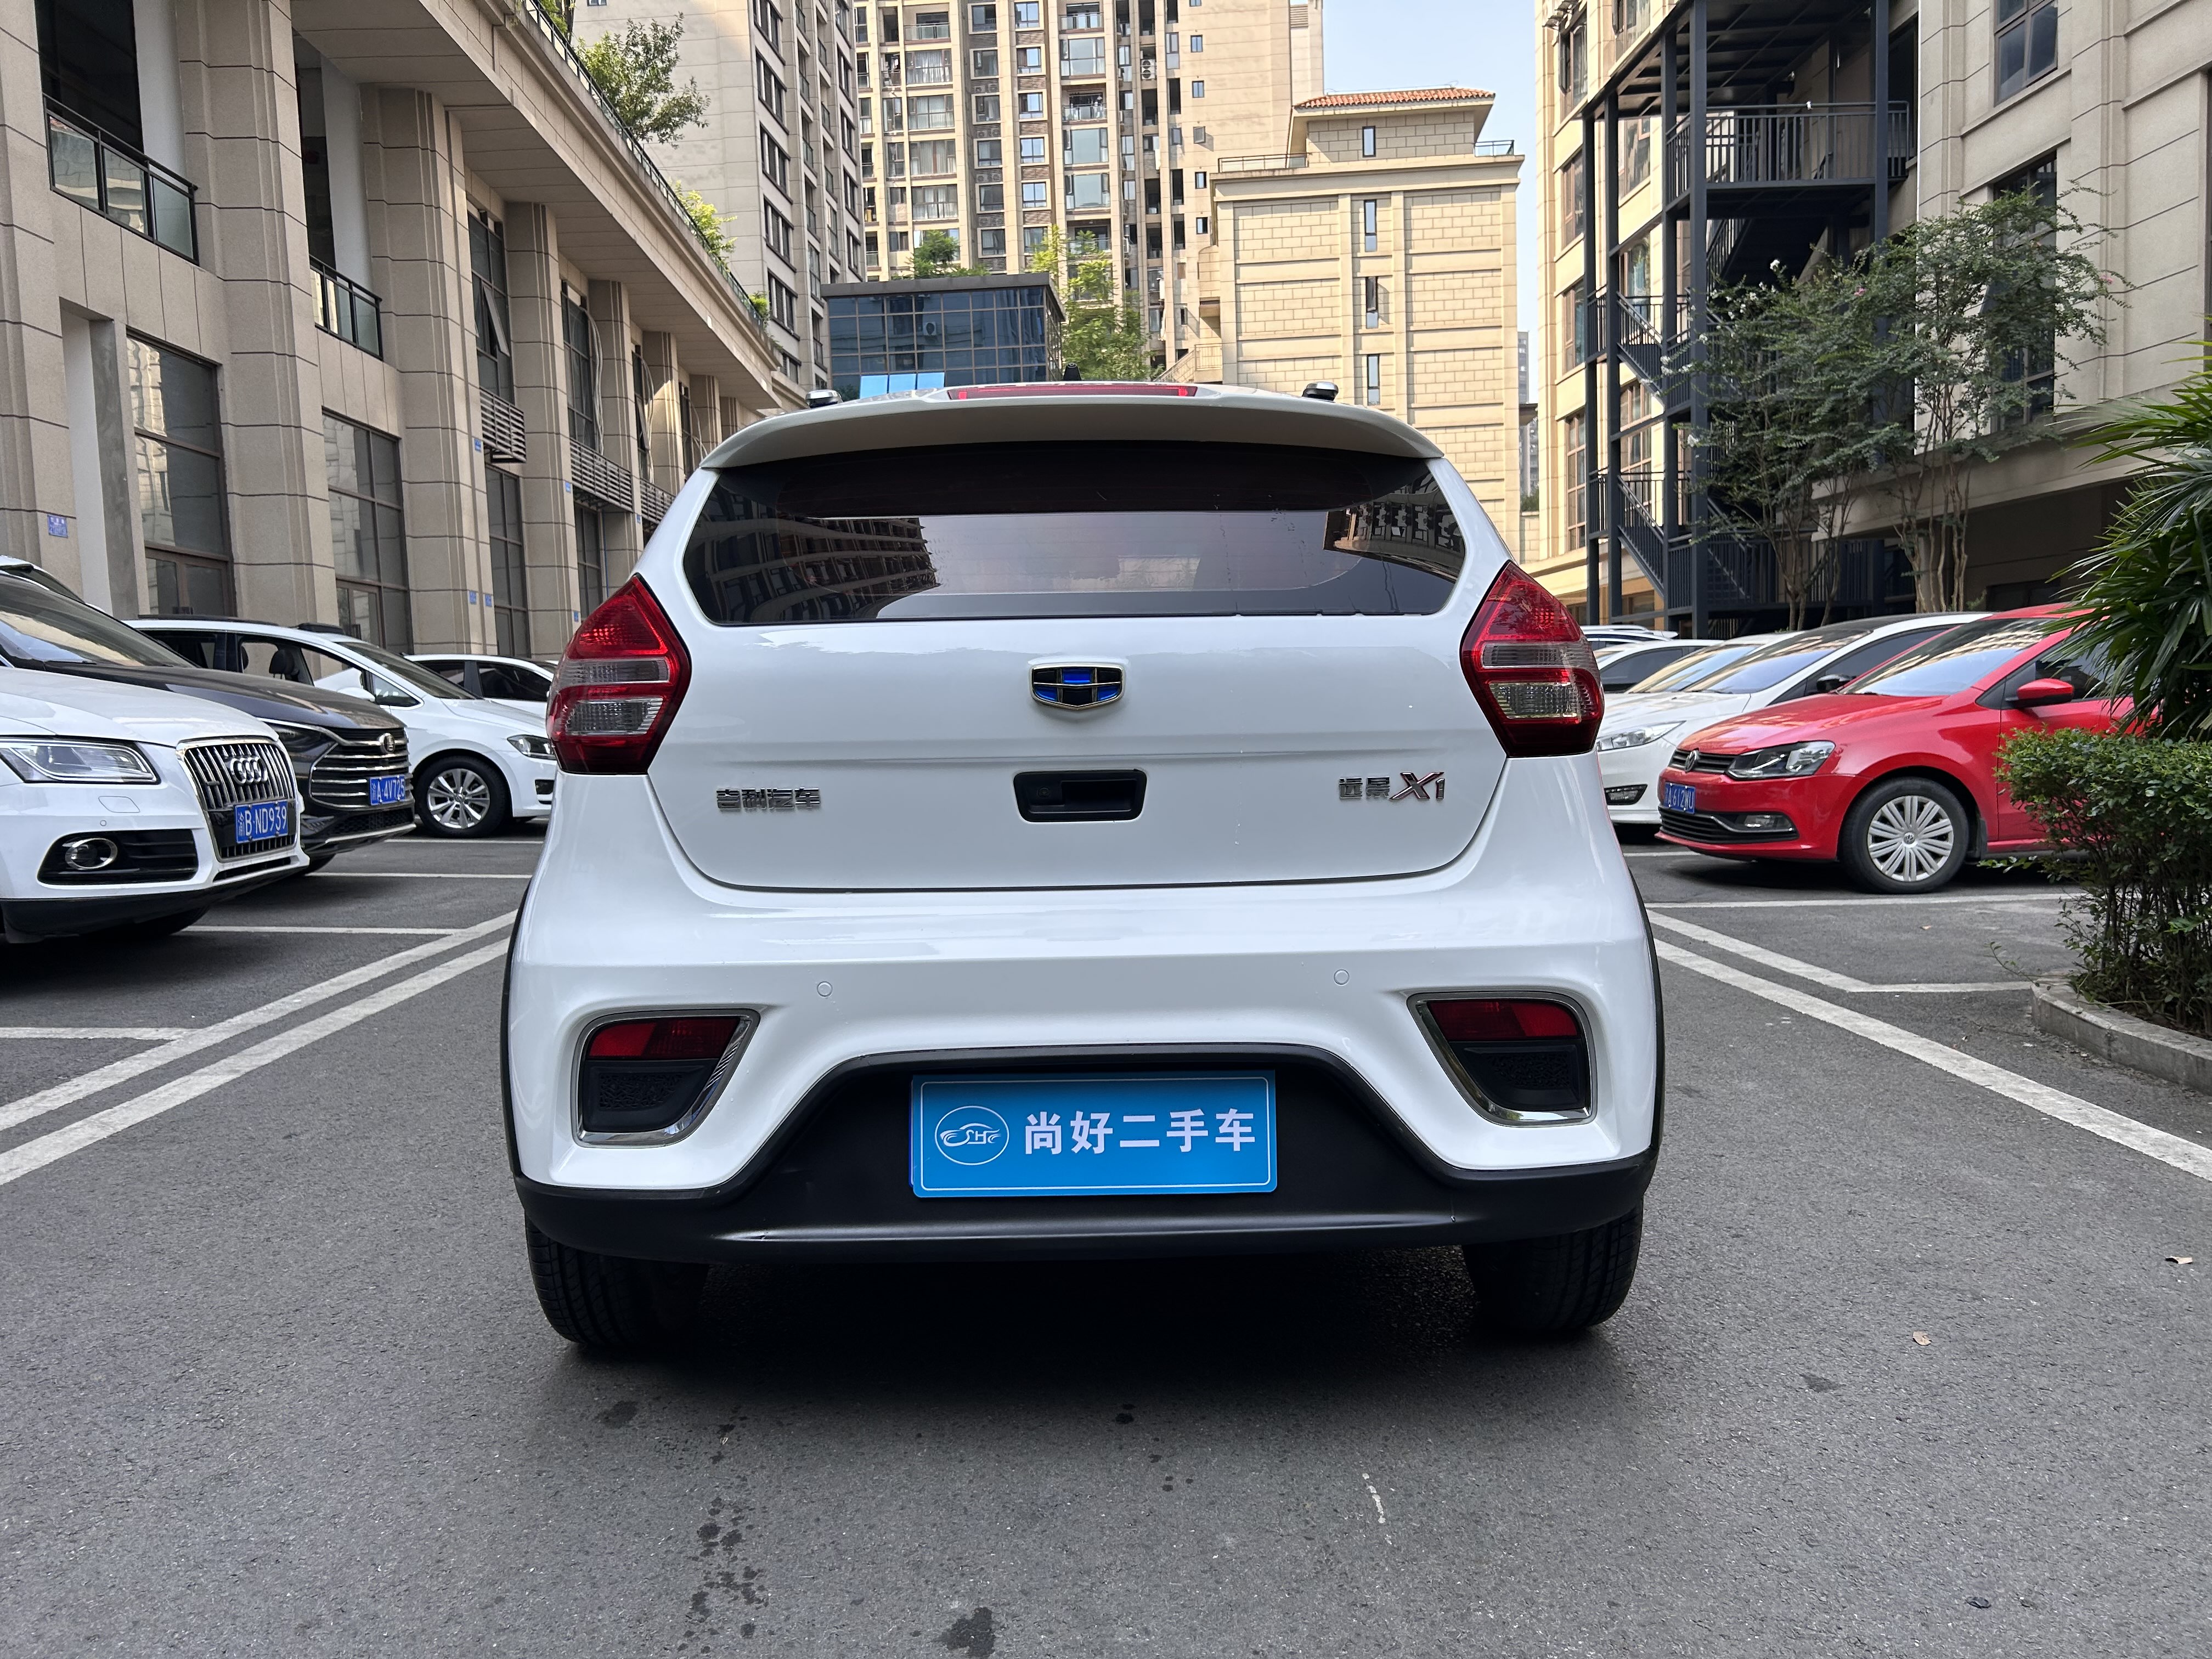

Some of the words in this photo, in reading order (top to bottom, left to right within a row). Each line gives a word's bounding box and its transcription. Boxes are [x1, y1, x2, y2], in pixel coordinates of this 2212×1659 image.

[716, 787, 821, 809] 吉利汽车
[1024, 1108, 1256, 1154] 尚好二手车
